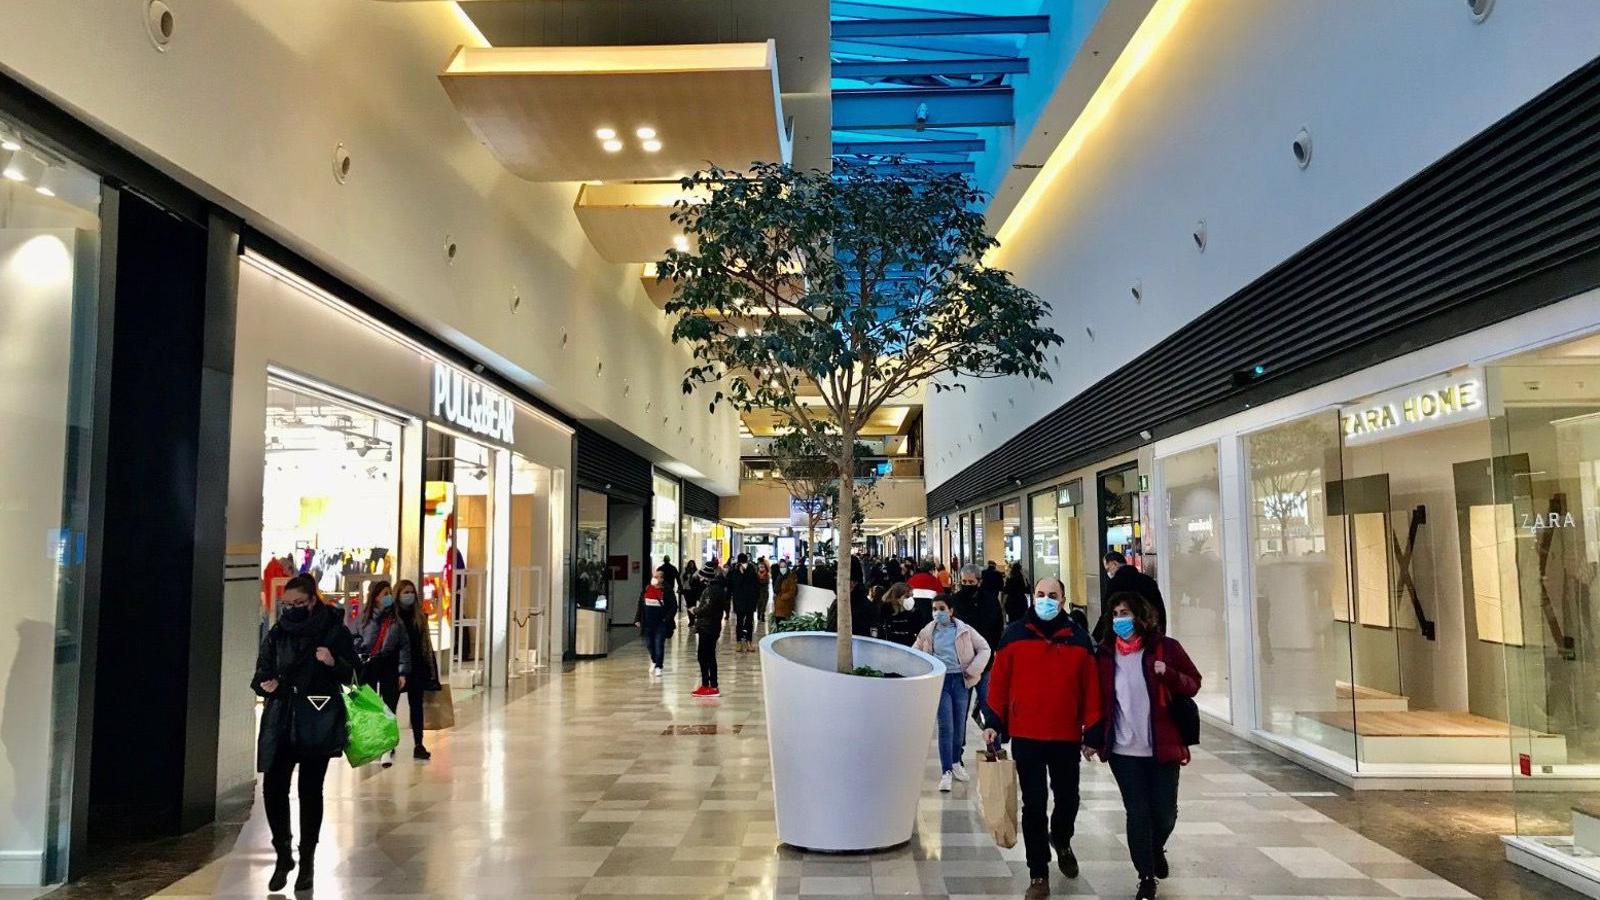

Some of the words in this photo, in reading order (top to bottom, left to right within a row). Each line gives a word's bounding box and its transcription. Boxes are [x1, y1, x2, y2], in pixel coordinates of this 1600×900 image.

[434, 361, 515, 444] PULL&BEAR
[1341, 404, 1397, 436] ZARA
[1402, 381, 1479, 423] HOME
[1520, 511, 1576, 529] ZARA
